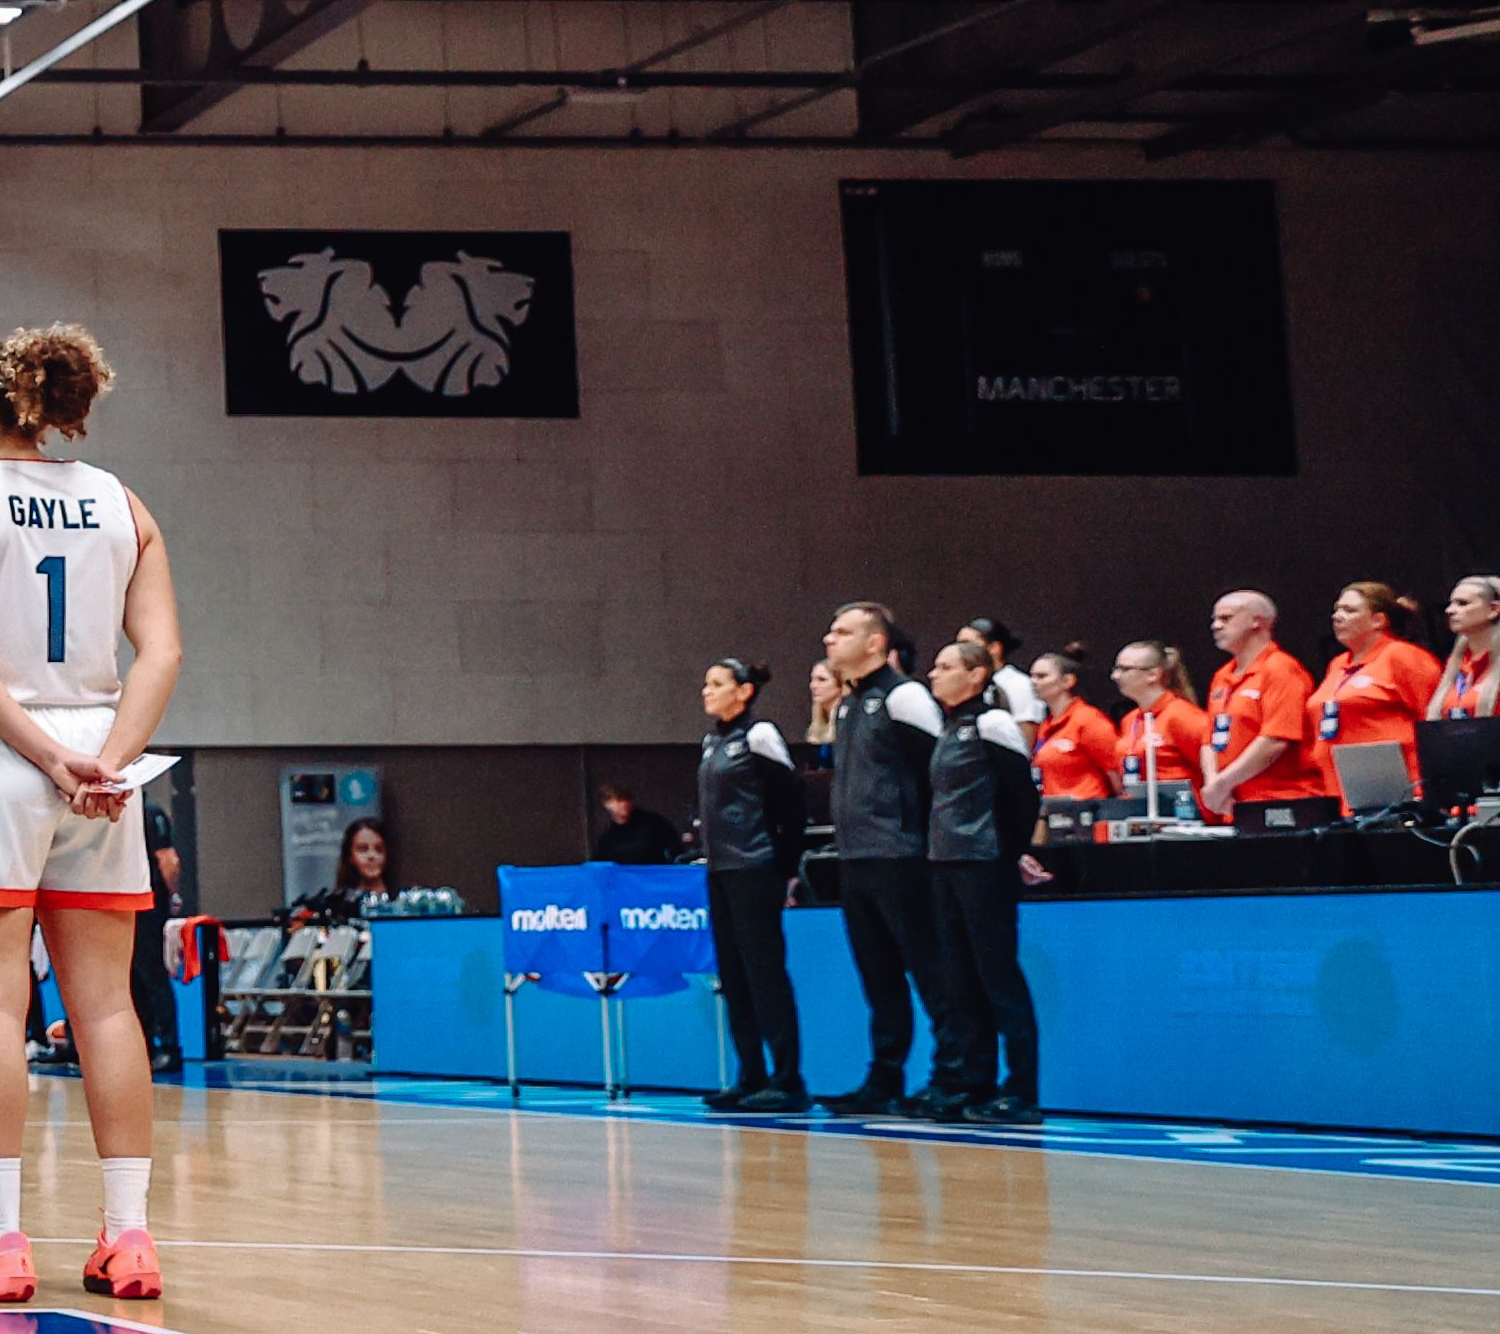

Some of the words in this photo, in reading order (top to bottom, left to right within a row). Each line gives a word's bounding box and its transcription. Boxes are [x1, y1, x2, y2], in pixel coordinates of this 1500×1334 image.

[976, 374, 1182, 403] MANCHESTER
[8, 494, 101, 530] GAYLE
[35, 555, 66, 663] 1
[511, 904, 588, 931] molten
[619, 903, 708, 931] molten
